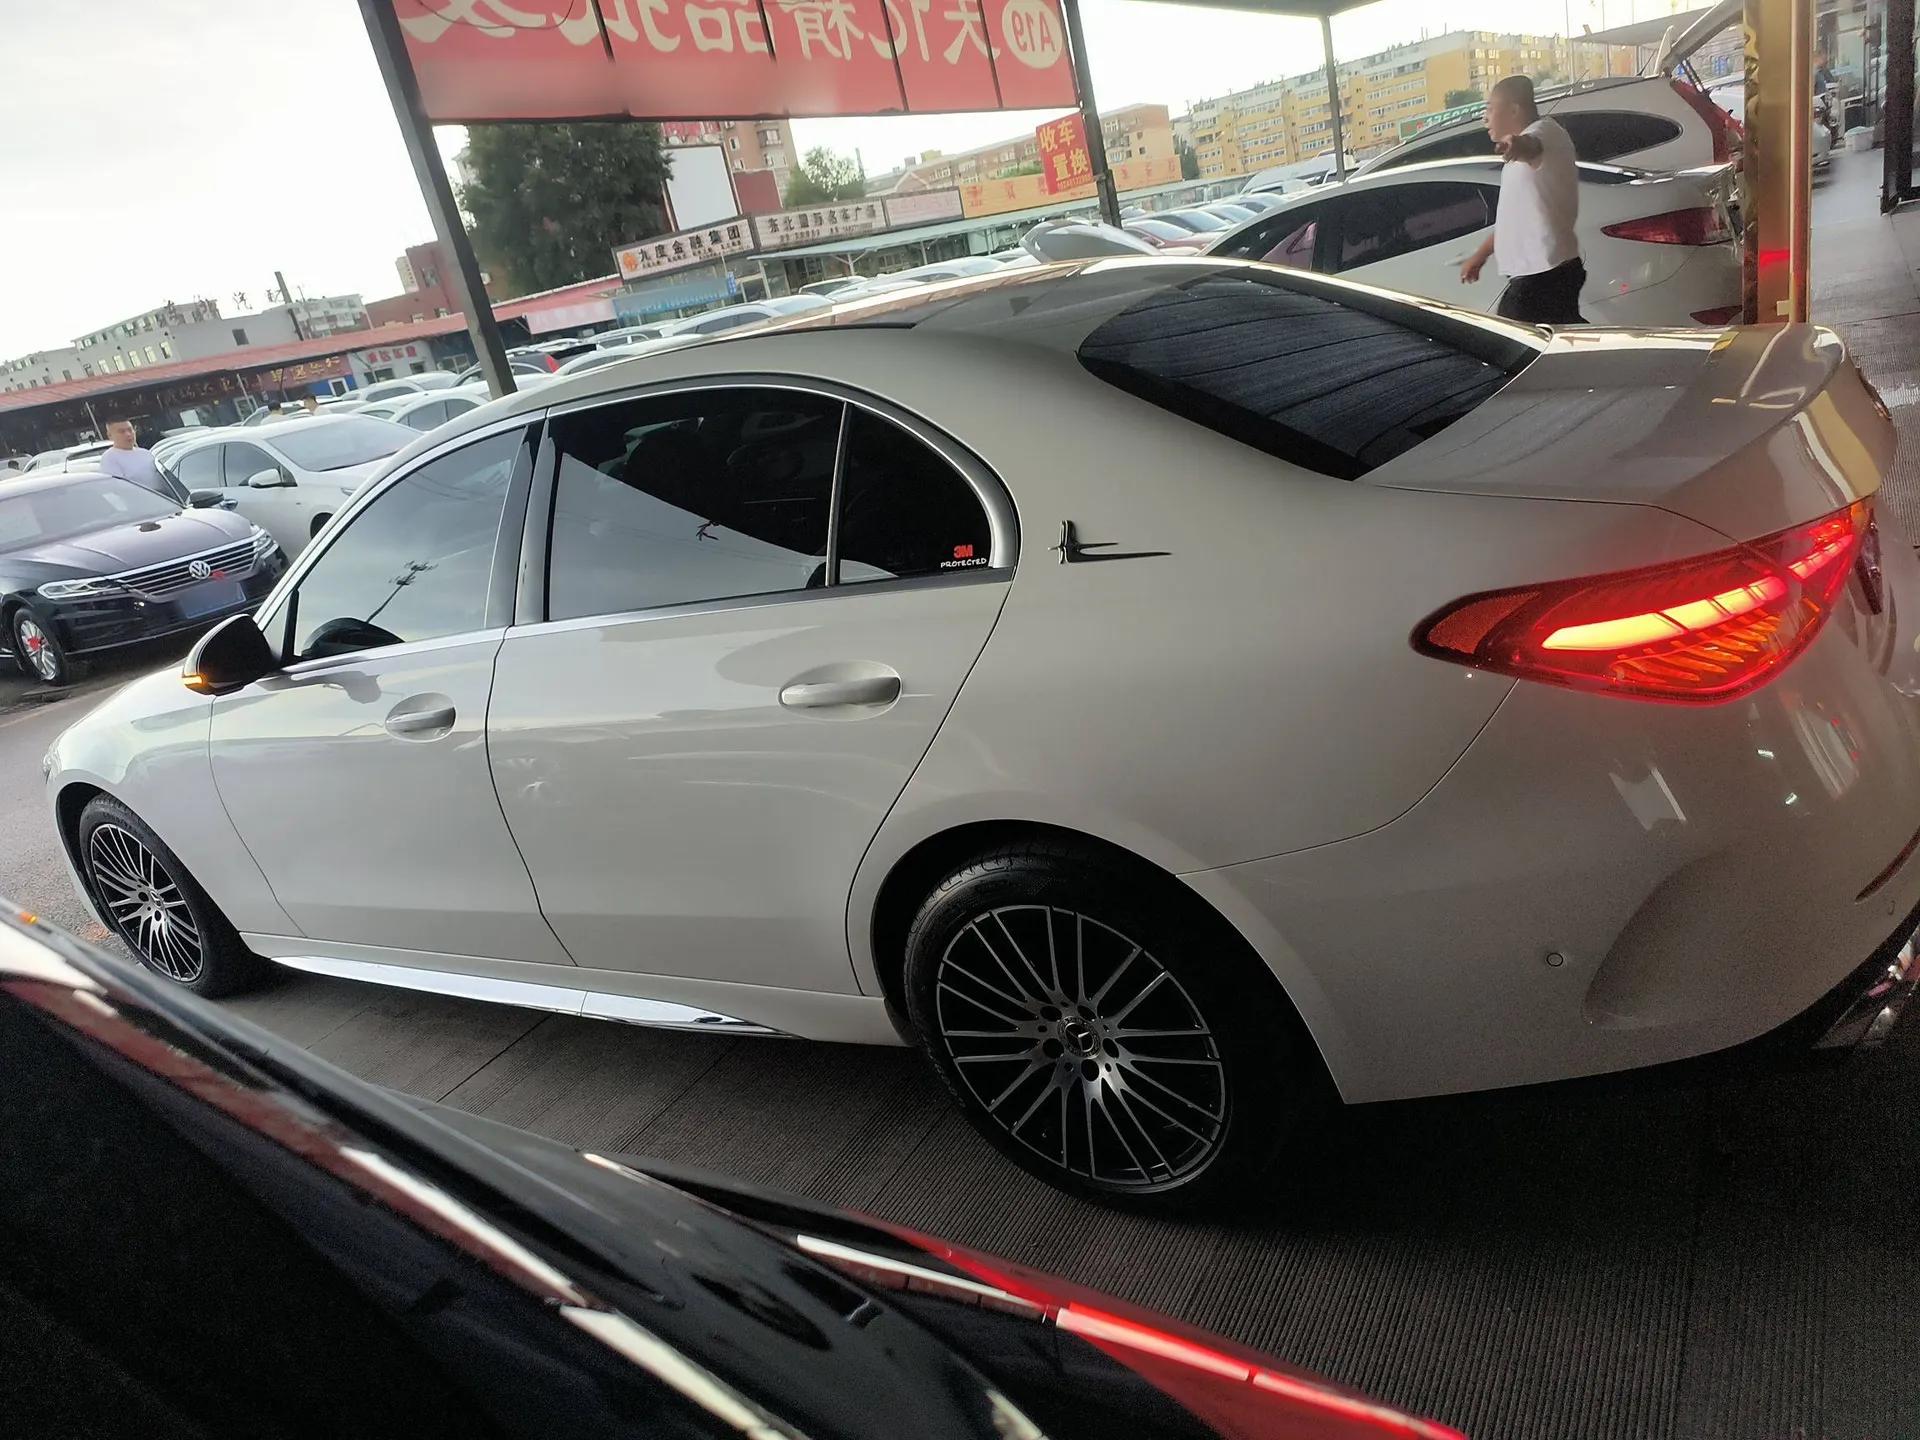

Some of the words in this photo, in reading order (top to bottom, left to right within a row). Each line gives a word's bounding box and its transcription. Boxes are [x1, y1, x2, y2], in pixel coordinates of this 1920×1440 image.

[1040, 120, 1076, 152] 收车
[1052, 148, 1090, 182] 置换
[638, 224, 741, 262] 九度金融集团
[940, 557, 987, 568] PROTECTED
[953, 544, 974, 559] 3M
